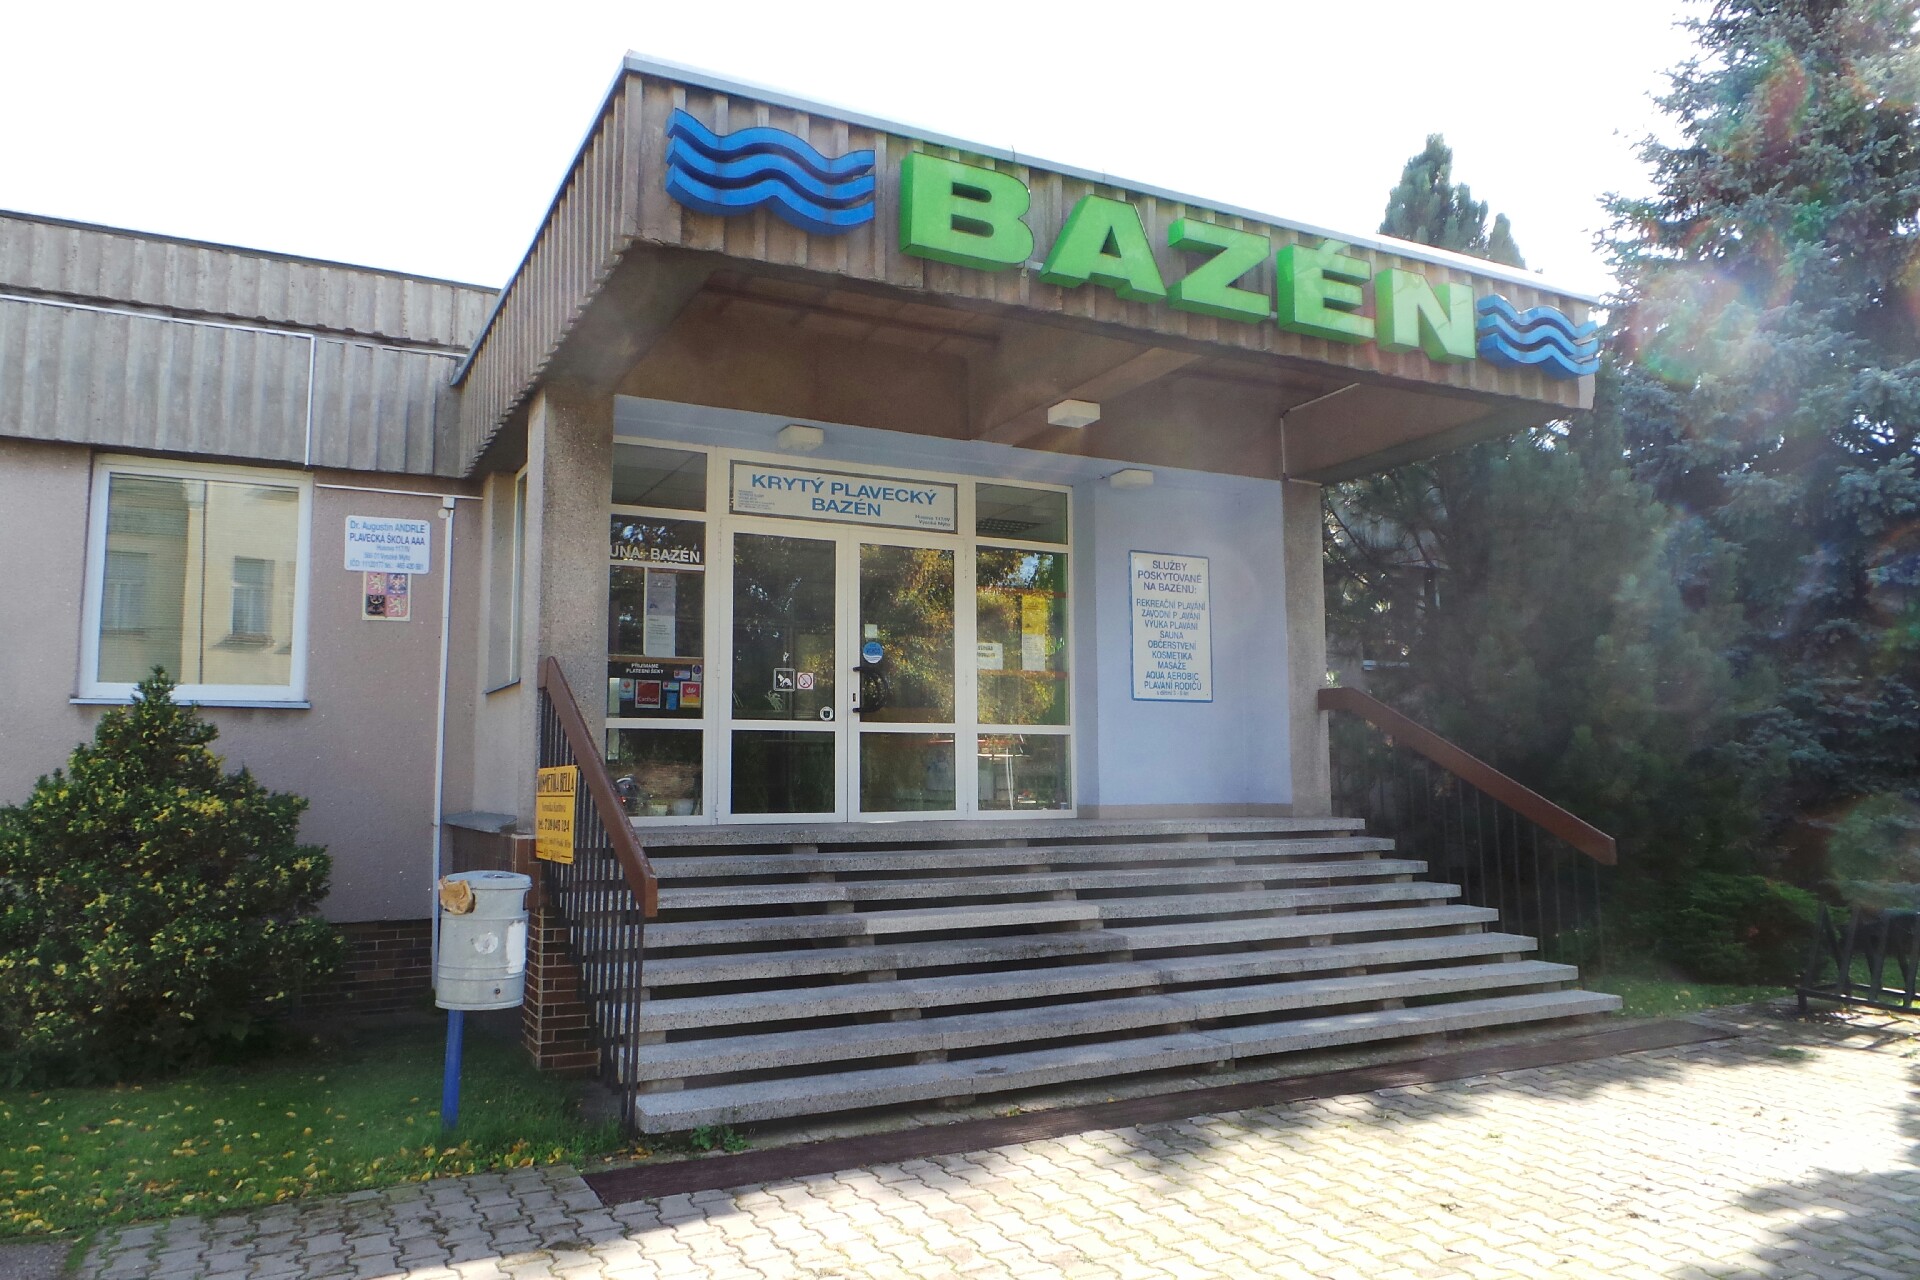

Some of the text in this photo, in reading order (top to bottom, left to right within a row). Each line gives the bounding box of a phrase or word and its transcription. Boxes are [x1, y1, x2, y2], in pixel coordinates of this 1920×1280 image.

[900, 152, 1476, 363] BAZÉN
[752, 473, 937, 505] KRYTÝ PLAVECKÝ
[811, 497, 881, 517] BAZÉN
[362, 521, 394, 533] Augustin
[395, 524, 425, 534] ANDRLE
[387, 533, 410, 545] ŠKOLA
[411, 537, 426, 546] AAA
[651, 546, 700, 563] BAZÉN
[1152, 559, 1187, 571] SLUŽBY
[1137, 570, 1202, 583] POSKYTOVANÉ
[1143, 582, 1197, 594] NA BAZÉNU:
[1136, 598, 1206, 611] REKREAČNÍ PLAVÁNÍ
[1144, 618, 1168, 628] VÝUKA
[1159, 630, 1184, 640] SAUNA
[1147, 639, 1197, 650] OBČERSTVENÍ
[1152, 651, 1193, 660] KOSMETIKA
[1145, 670, 1199, 681] AQUA AEROBIC
[1174, 680, 1202, 691] RODIČŮ
